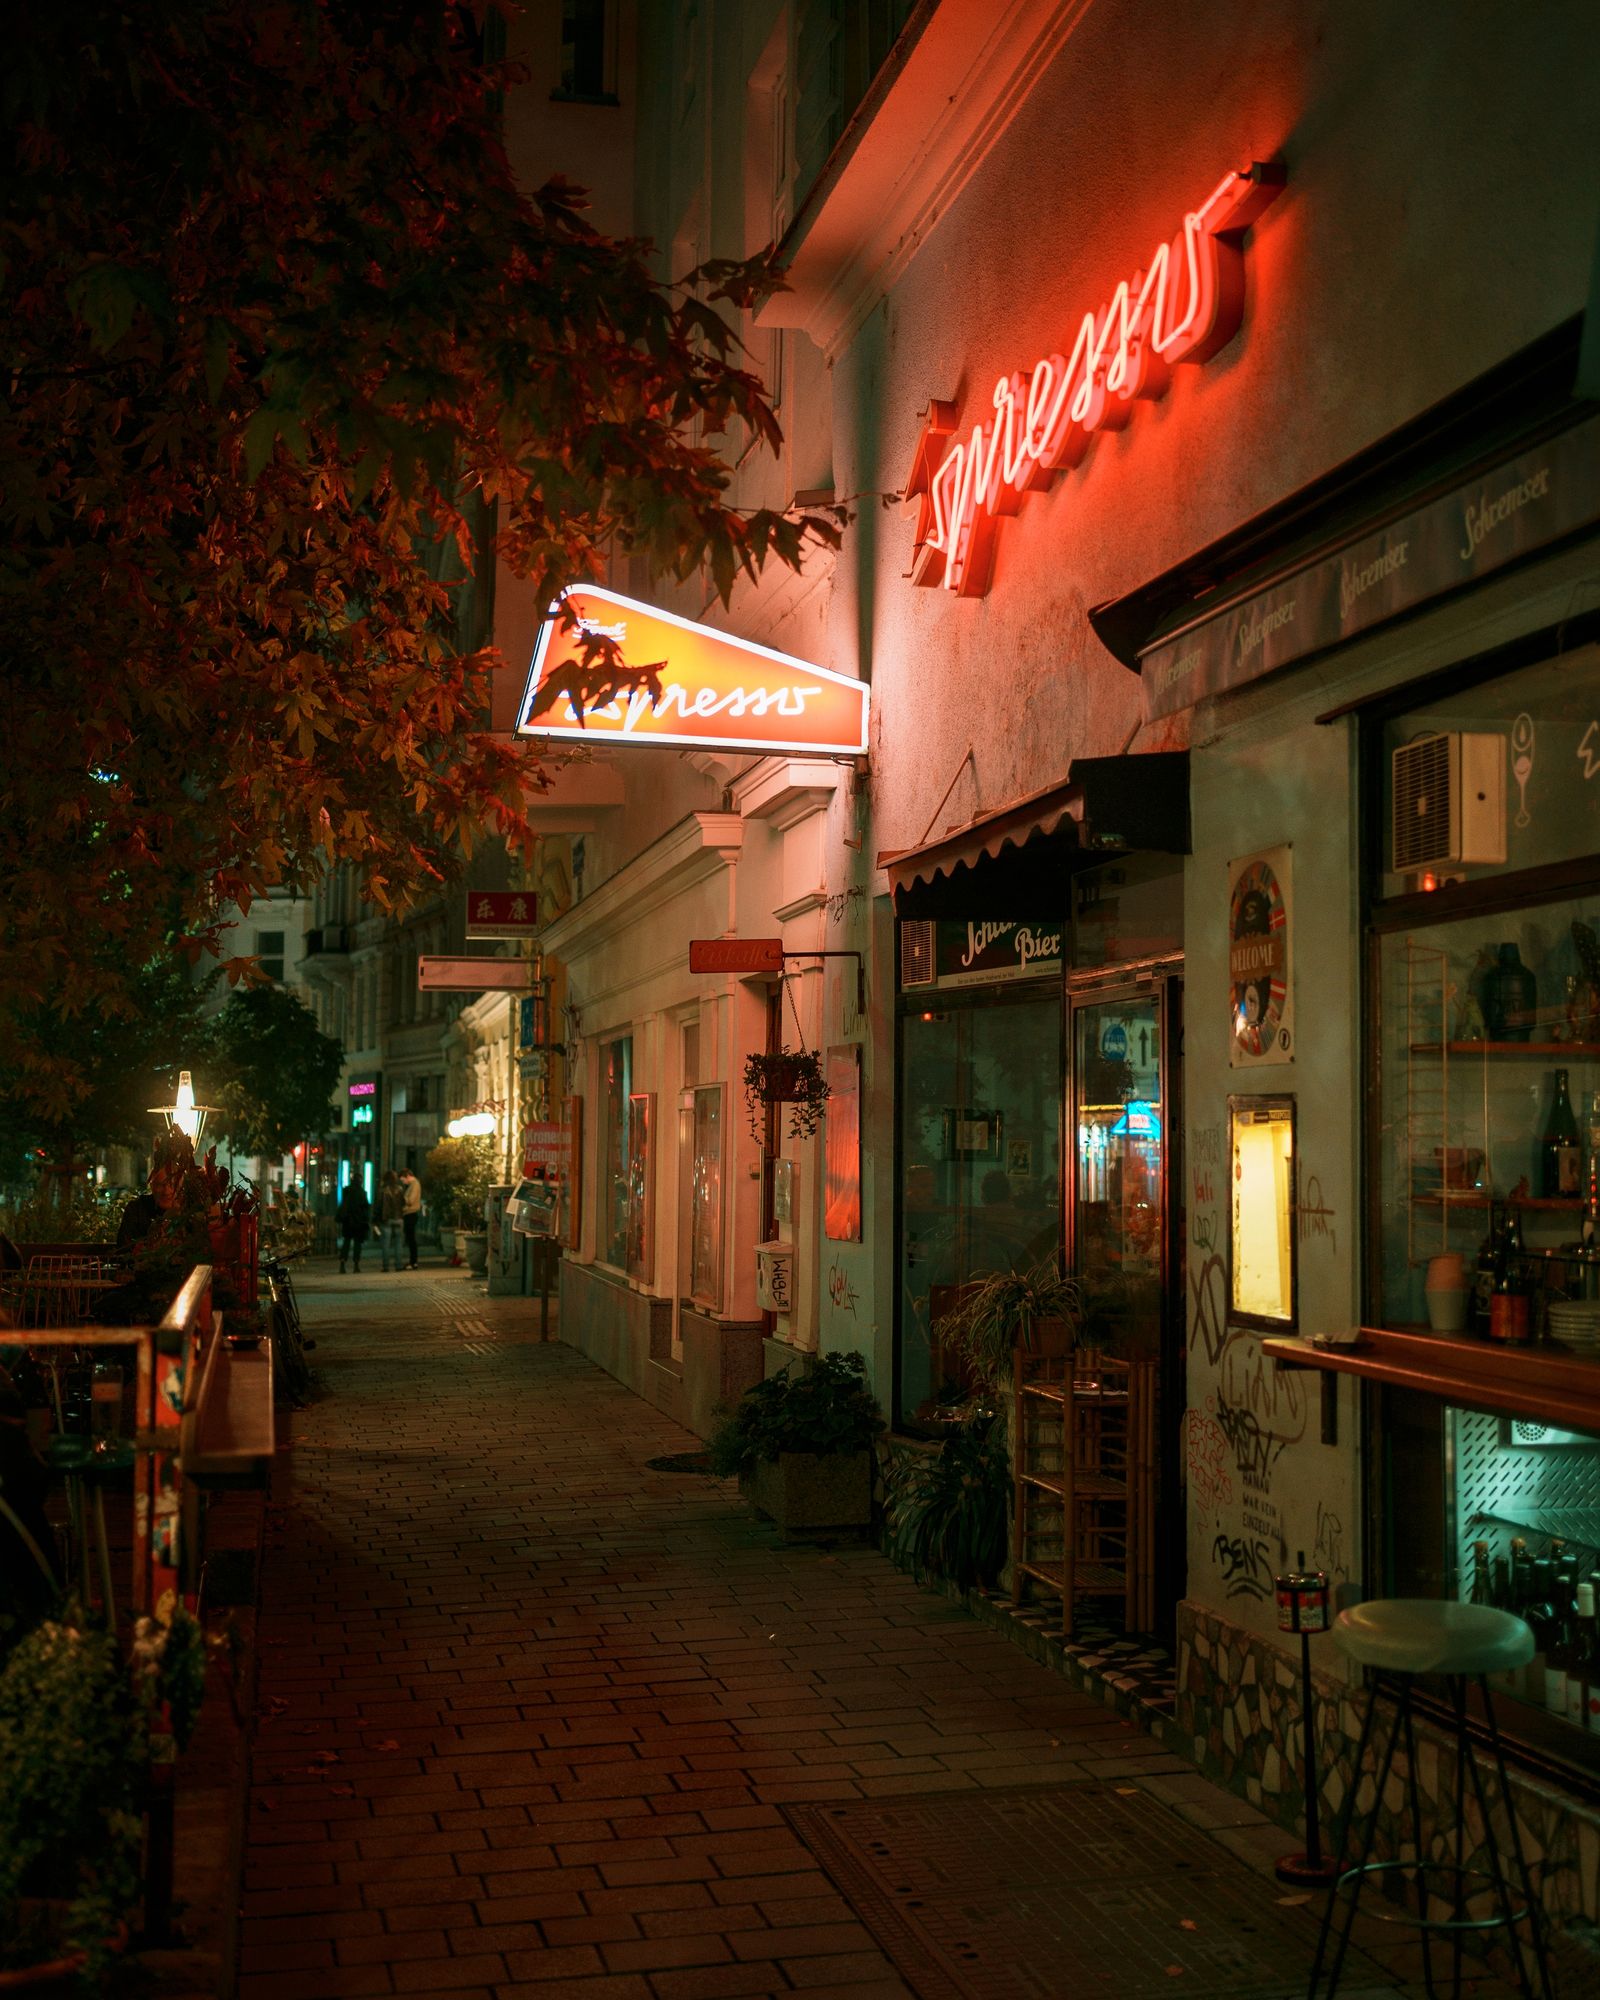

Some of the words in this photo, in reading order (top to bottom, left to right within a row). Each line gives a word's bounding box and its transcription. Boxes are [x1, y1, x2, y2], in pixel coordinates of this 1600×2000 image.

[1460, 468, 1552, 560] Schremser
[1014, 928, 1061, 971] Bier
[1231, 943, 1275, 972] WELCOME
